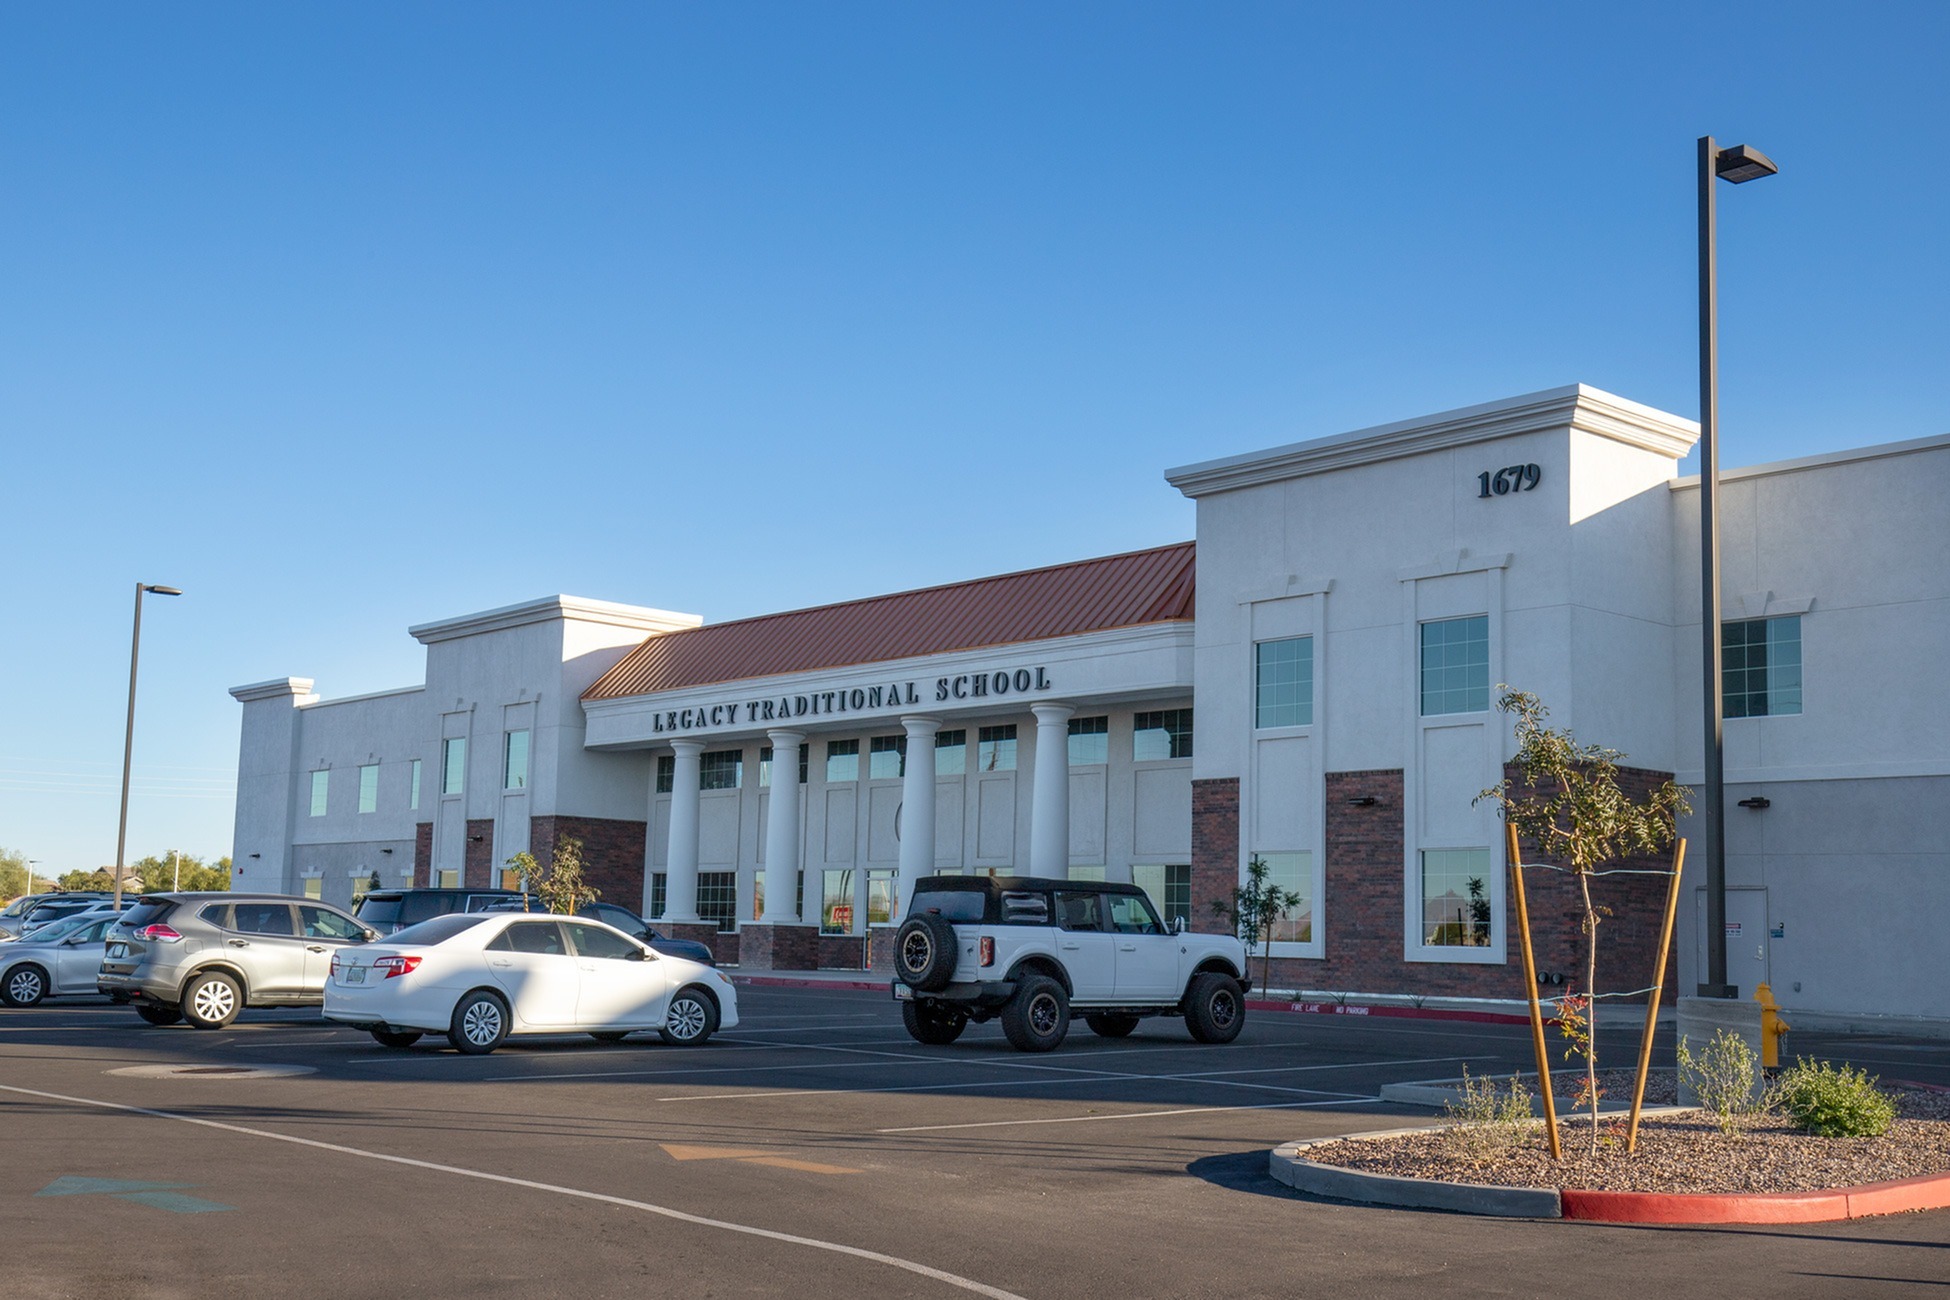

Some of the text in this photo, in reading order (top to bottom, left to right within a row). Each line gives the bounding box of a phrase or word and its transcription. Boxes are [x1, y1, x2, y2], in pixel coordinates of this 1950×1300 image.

[1477, 463, 1541, 498] 1679
[652, 667, 1050, 732] LEGACY TRADITIONAL SCHOOL
[1291, 1003, 1369, 1016] FIRE LANE NO PARKING
